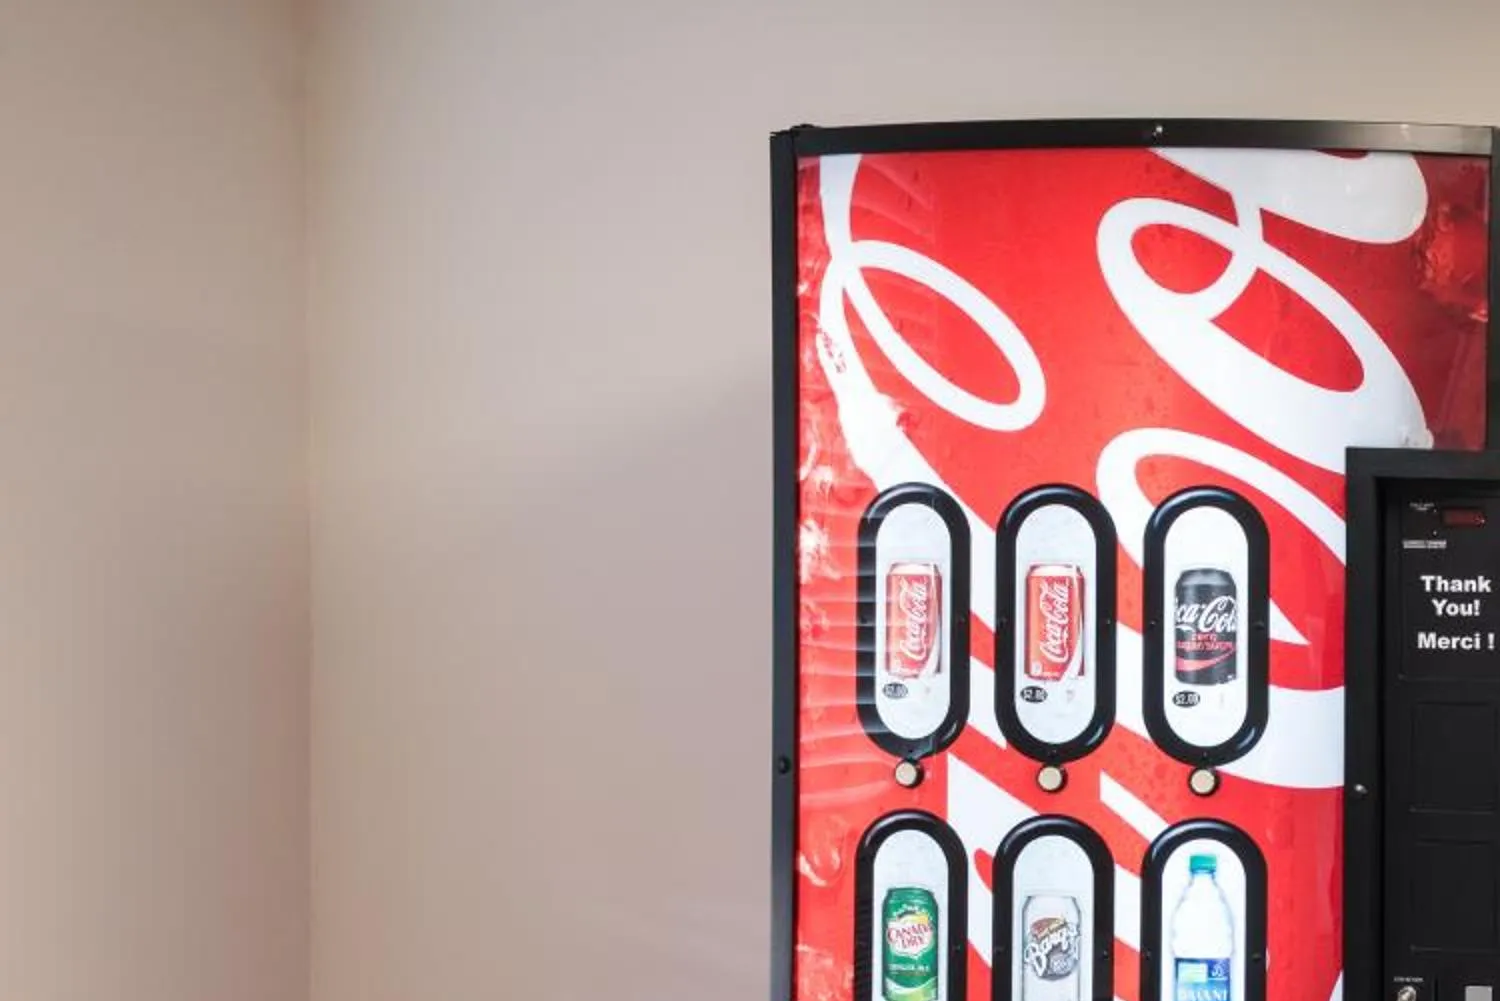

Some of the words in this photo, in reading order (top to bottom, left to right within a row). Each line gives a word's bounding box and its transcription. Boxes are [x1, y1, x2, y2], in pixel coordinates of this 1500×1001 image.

[1420, 575, 1492, 593] Thank
[1432, 599, 1480, 616] You!
[1417, 632, 1481, 650] Merci
[887, 923, 932, 943] CANADA
